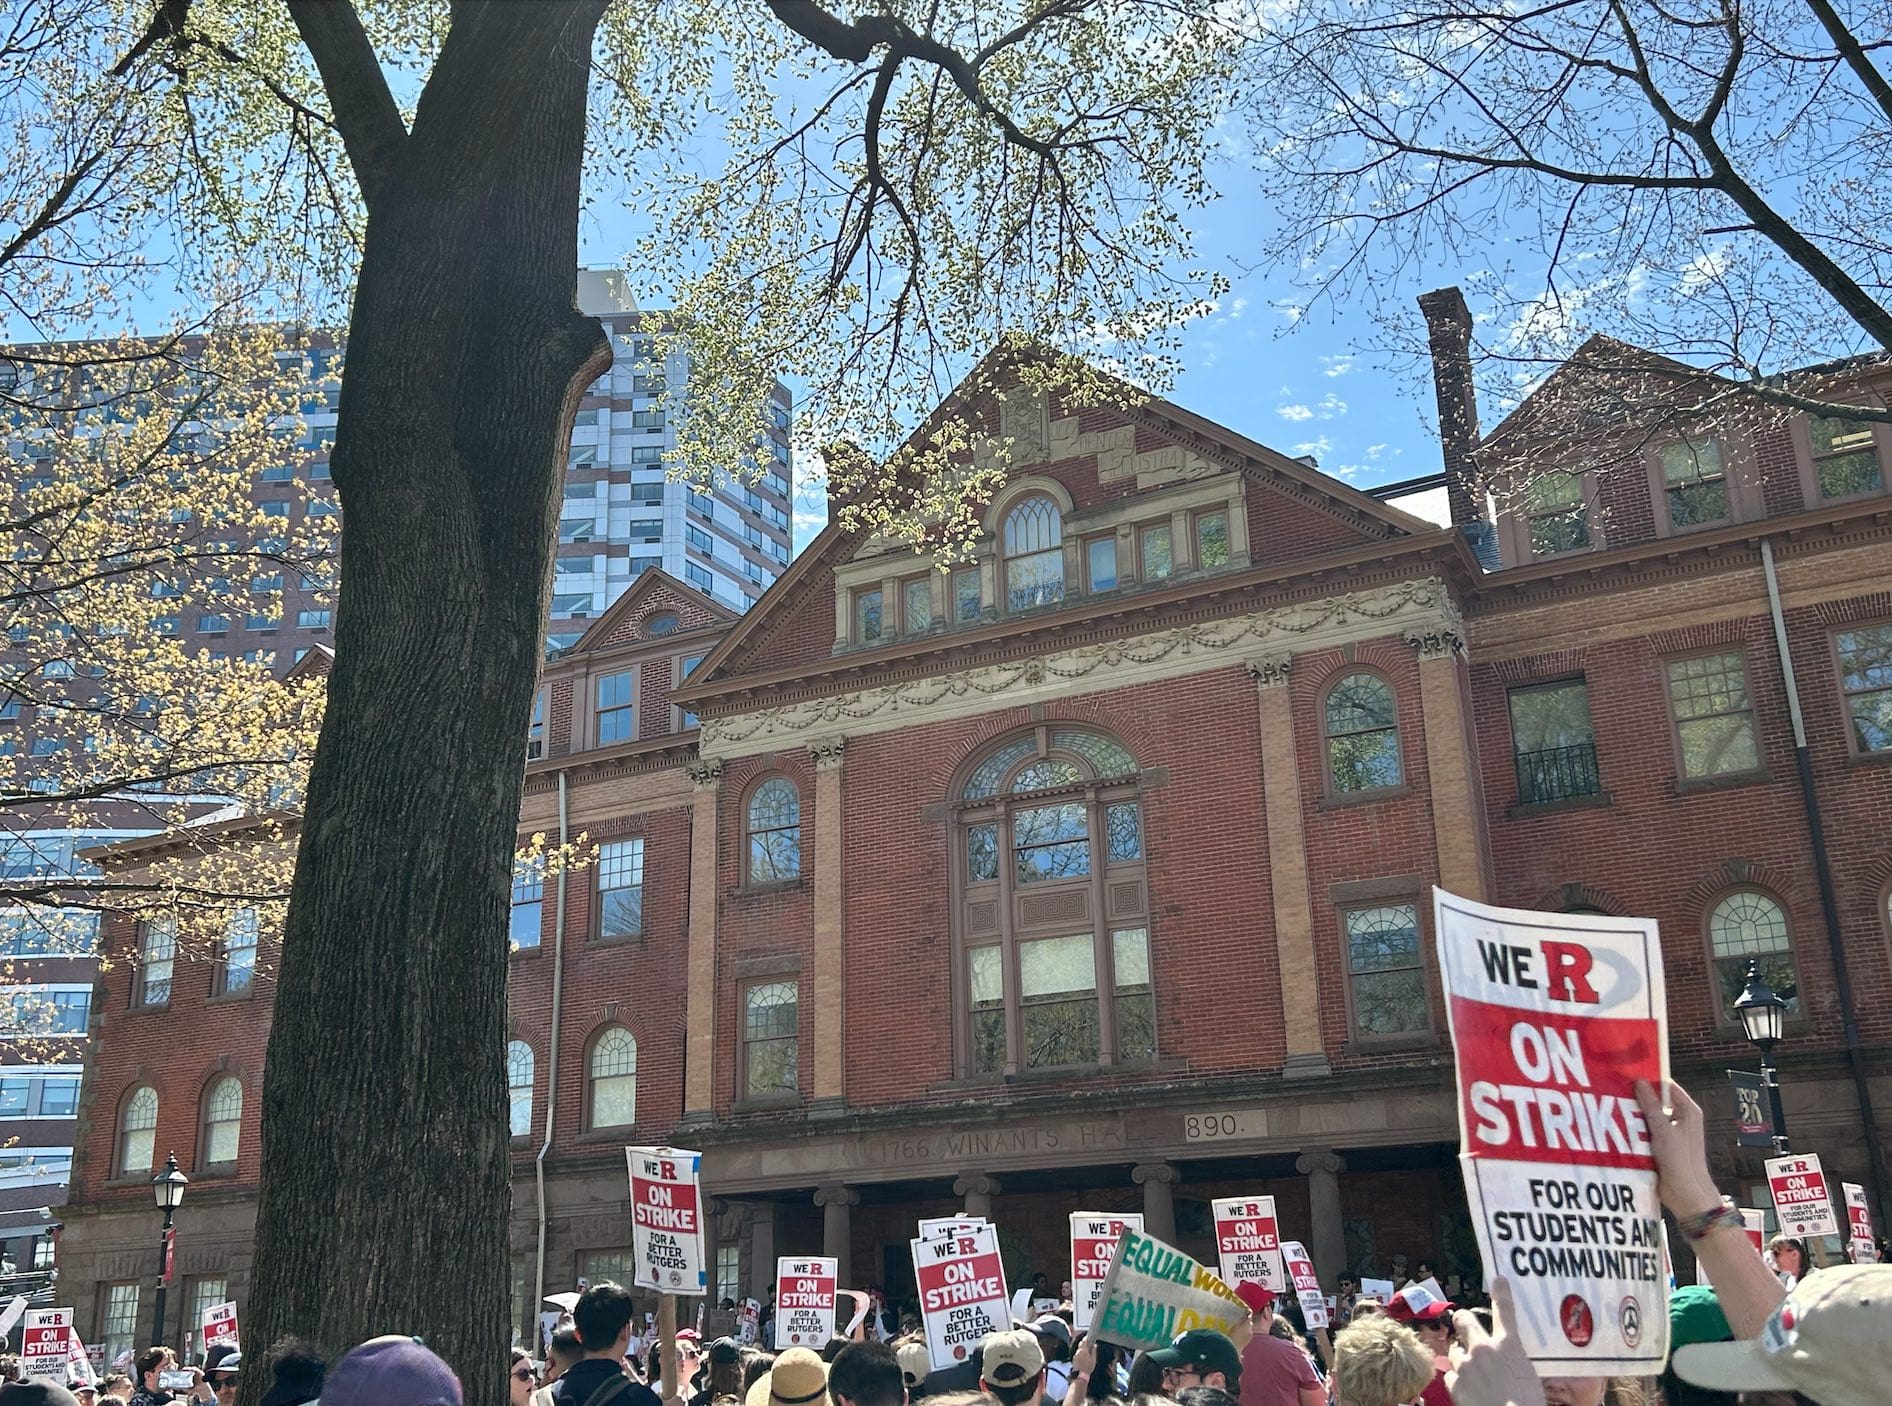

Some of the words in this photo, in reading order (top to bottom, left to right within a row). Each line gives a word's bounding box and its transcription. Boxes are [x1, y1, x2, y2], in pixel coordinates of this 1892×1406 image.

[1477, 938, 1538, 989] WE
[1540, 940, 1600, 1004] R
[1510, 1022, 1591, 1087] ON
[1735, 1087, 1759, 1104] TOP
[1470, 1081, 1651, 1155] STRIKE
[1740, 1102, 1763, 1124] 20
[881, 1140, 929, 1162] 1766
[947, 1130, 1059, 1156] WINANTS
[1080, 1120, 1160, 1146] HALL
[643, 1160, 658, 1176] WE
[660, 1160, 677, 1180] R
[1778, 1164, 1793, 1173] WE
[1793, 1161, 1809, 1172] R
[1787, 1176, 1806, 1189] ON
[648, 1185, 672, 1207] ON
[1529, 1179, 1581, 1210] FOR
[1586, 1182, 1636, 1213] OUR
[1776, 1186, 1825, 1203] STRIKE
[636, 1203, 694, 1229] STRIKE
[1228, 1206, 1244, 1216] WE
[1245, 1203, 1260, 1217] R
[1786, 1214, 1828, 1223] COMMUNITIES
[1089, 1223, 1107, 1234] WE
[1109, 1221, 1125, 1236] R
[1235, 1221, 1257, 1236] ON
[1494, 1211, 1626, 1245] STUDENTS
[1632, 1218, 1659, 1249] AND
[650, 1232, 667, 1245] FOR
[669, 1235, 677, 1246] A
[933, 1242, 956, 1257] WE
[957, 1237, 978, 1255] R
[1222, 1235, 1275, 1251] STRIKE
[648, 1242, 682, 1258] BETTER
[647, 1252, 687, 1270] RUTGERS
[1122, 1232, 1195, 1287] EQUAL
[1235, 1262, 1267, 1270] BETTER
[1238, 1255, 1254, 1263] FOR
[1511, 1246, 1657, 1282] COMMUNITIES
[794, 1264, 808, 1273] WE
[810, 1263, 823, 1275] R
[944, 1261, 974, 1283] ON
[1234, 1269, 1272, 1279] RUTGERS
[797, 1279, 817, 1292] ON
[926, 1276, 1001, 1309] STRIKE
[781, 1293, 832, 1307] STRIKE
[39, 1315, 53, 1325] WE
[54, 1313, 62, 1325] R
[212, 1312, 224, 1321] WE
[224, 1308, 230, 1319] R
[950, 1308, 972, 1321] FOR
[975, 1306, 983, 1316] A
[1101, 1296, 1177, 1346] EQUAL
[216, 1323, 230, 1335] ON
[946, 1315, 991, 1334] BETTER
[41, 1329, 58, 1341] ON
[27, 1341, 67, 1354] STRIKE
[26, 1368, 63, 1376] COMMUNITIES
